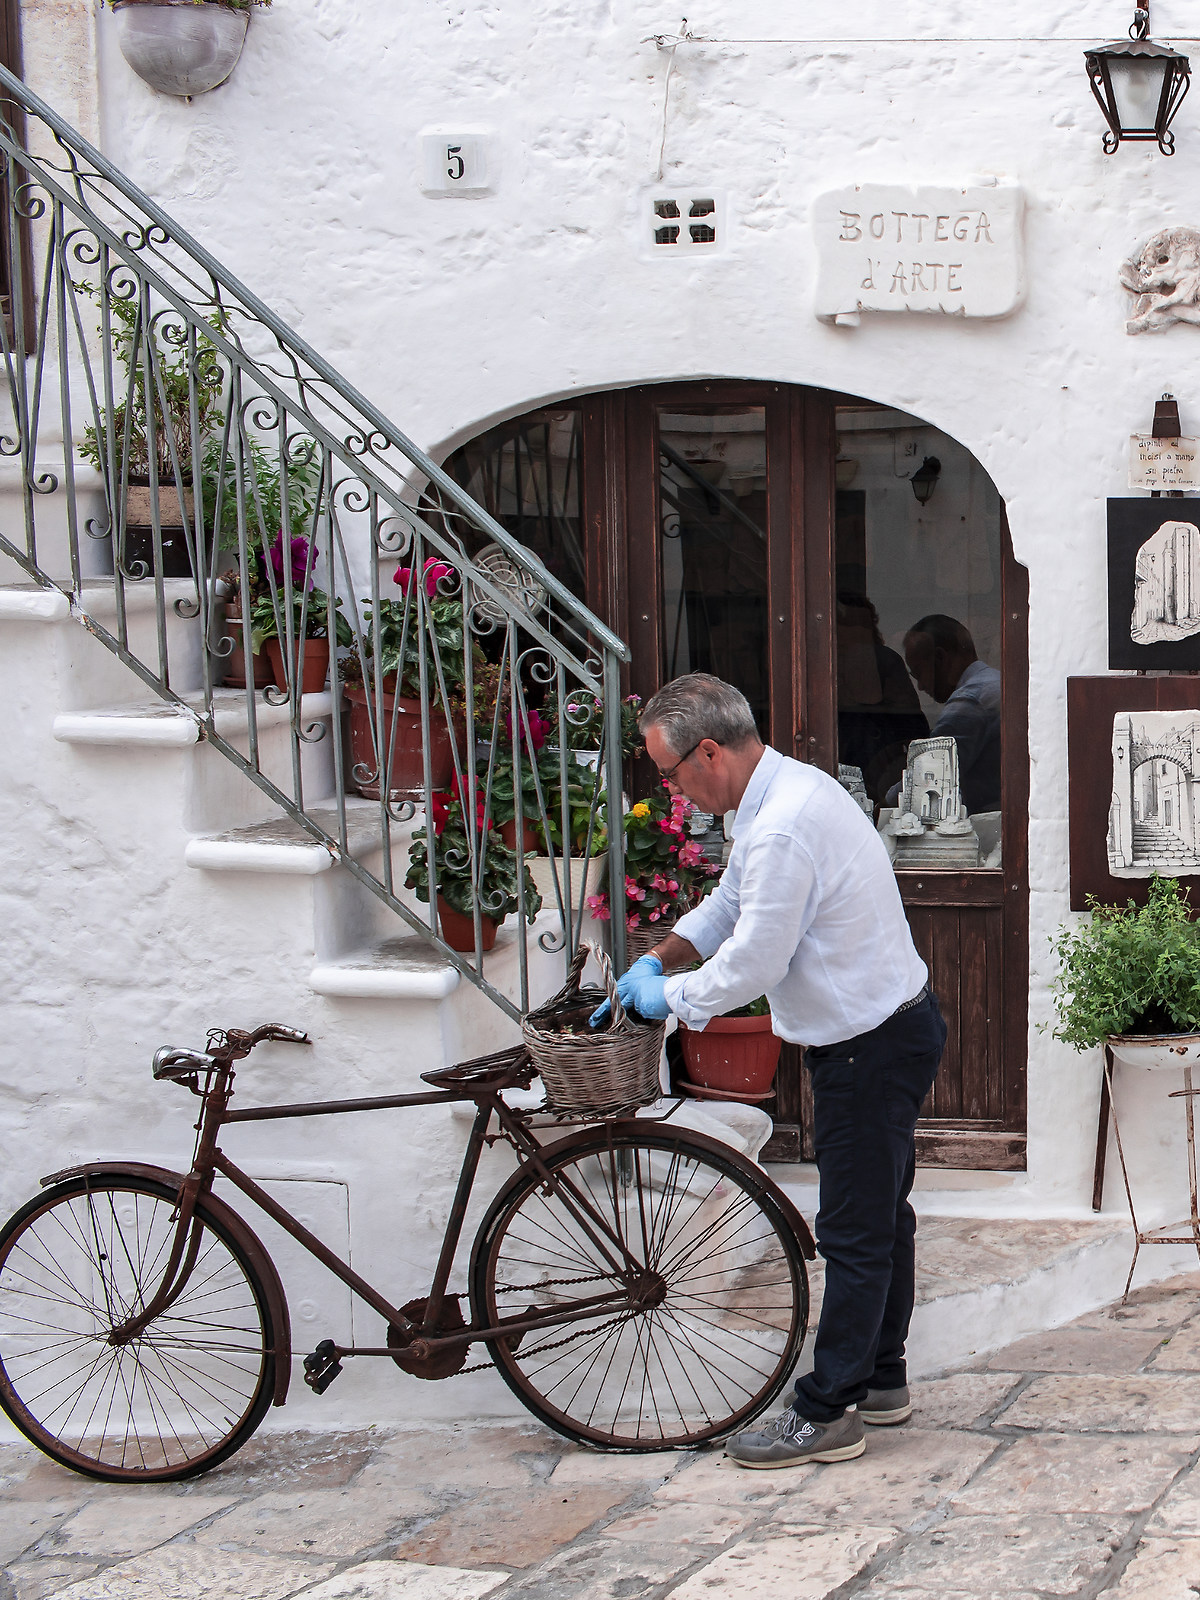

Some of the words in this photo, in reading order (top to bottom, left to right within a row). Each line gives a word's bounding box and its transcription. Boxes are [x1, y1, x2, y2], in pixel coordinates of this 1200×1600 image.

[447, 145, 465, 180] 5
[839, 209, 994, 244] BOTTEGA
[860, 258, 962, 295] d'ARTE
[1162, 464, 1183, 479] pietra
